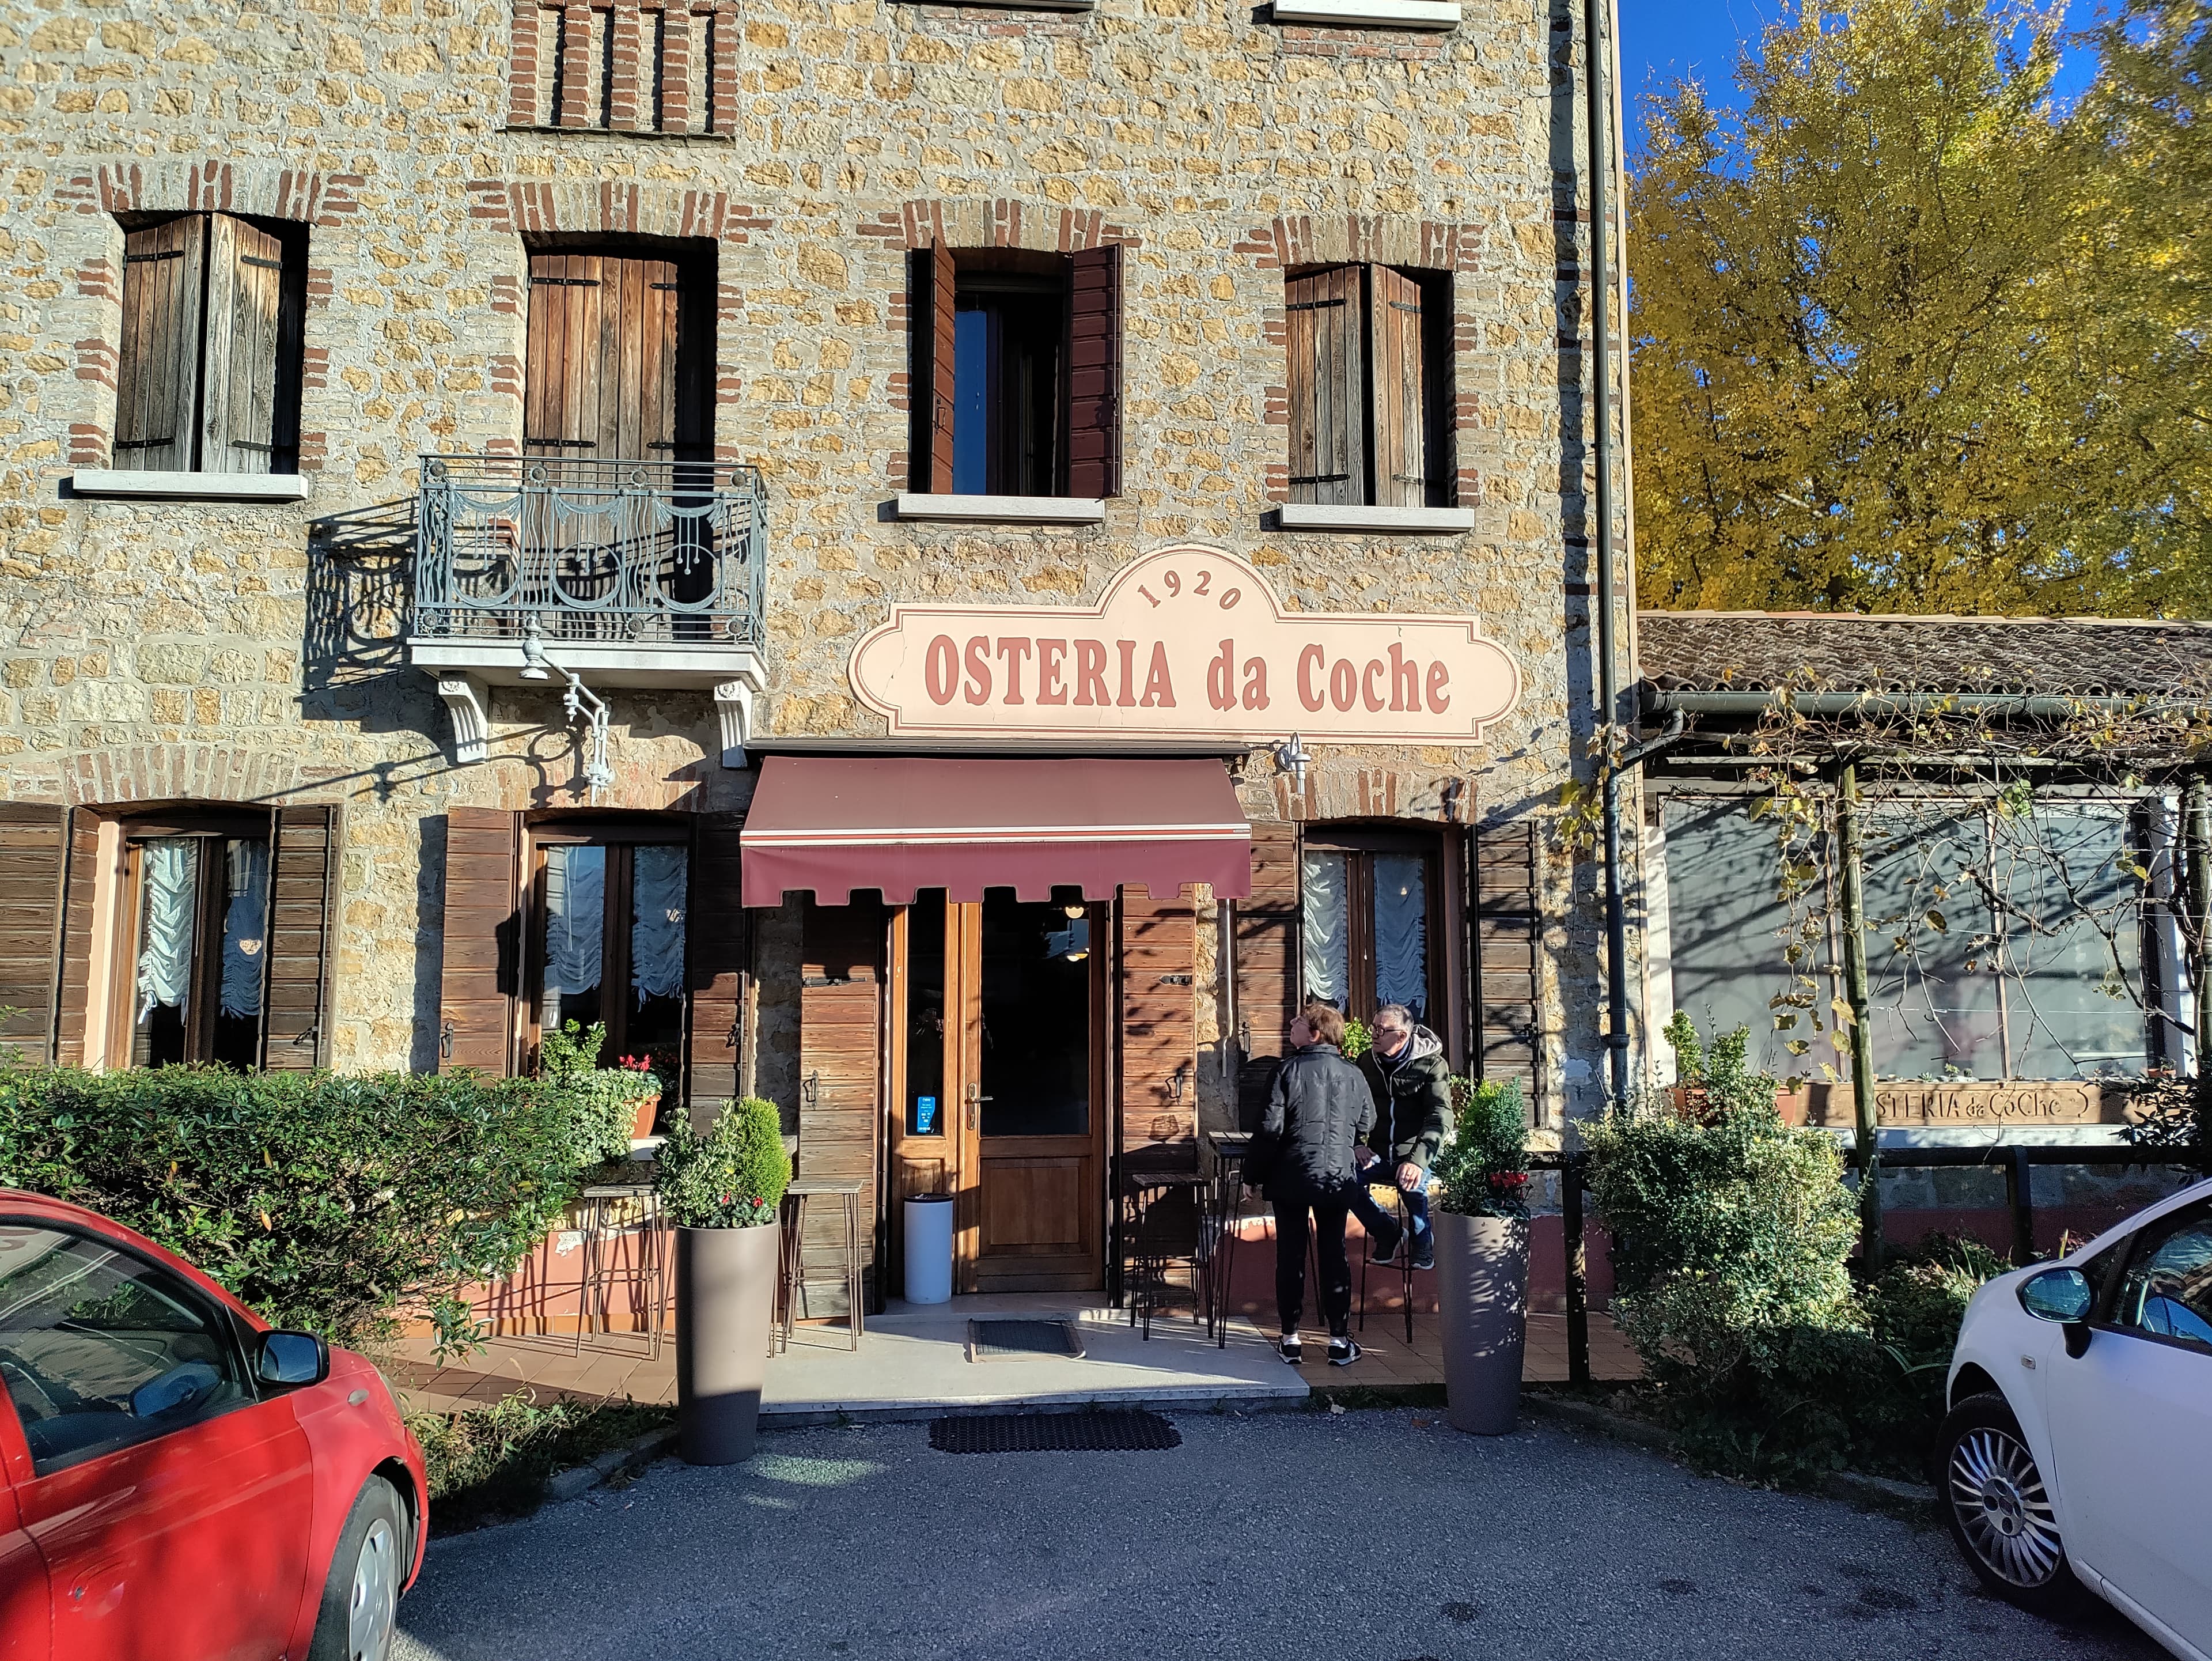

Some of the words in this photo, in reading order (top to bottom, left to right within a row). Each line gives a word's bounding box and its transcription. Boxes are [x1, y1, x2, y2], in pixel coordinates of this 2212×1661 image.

[1137, 570, 1241, 610] 1920
[925, 634, 1177, 708] OSTERIA
[1207, 638, 1271, 712] da
[1296, 642, 1450, 715] Coche
[1874, 1092, 1960, 1118] STERIA
[1965, 1096, 1985, 1117] da
